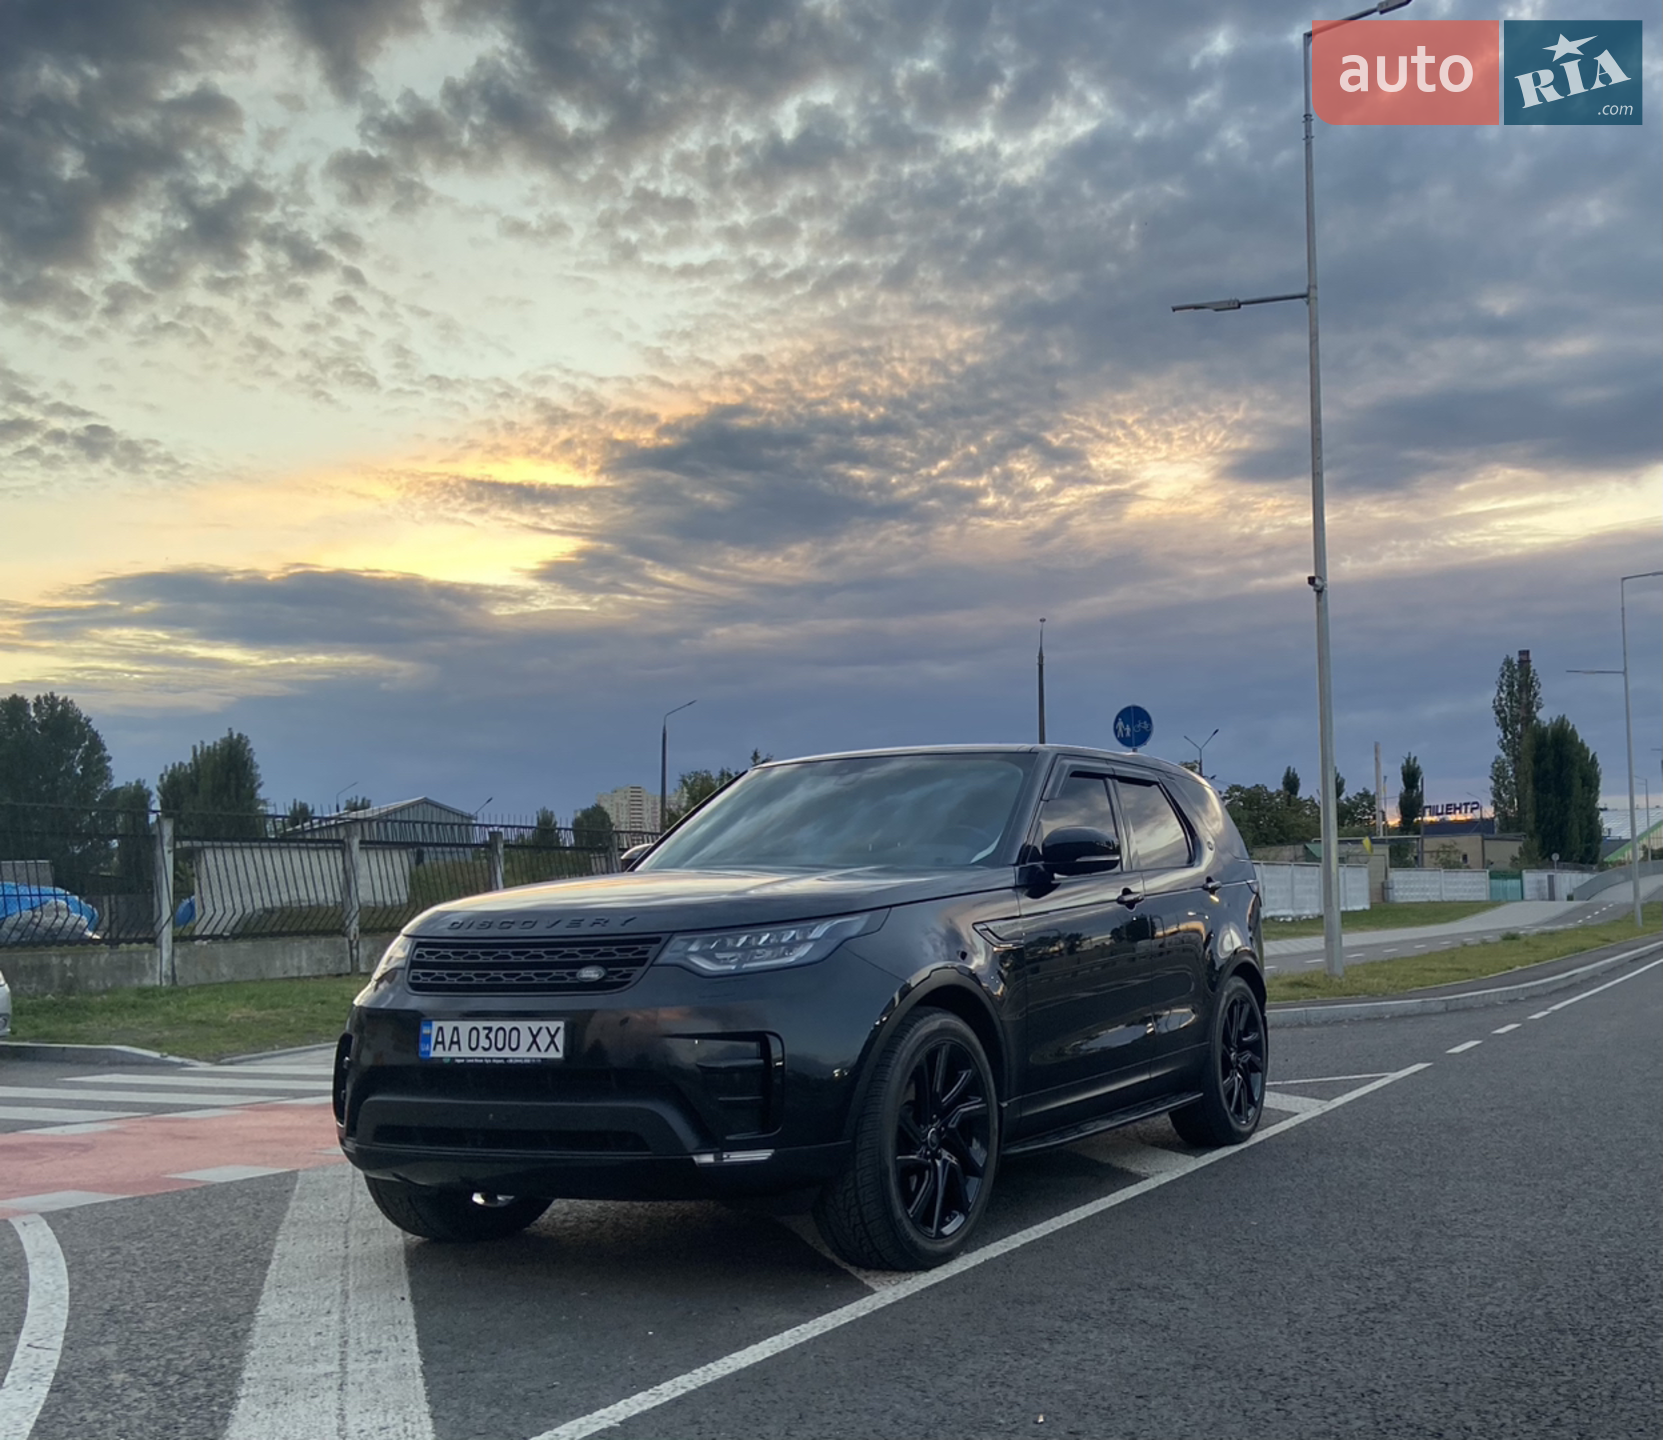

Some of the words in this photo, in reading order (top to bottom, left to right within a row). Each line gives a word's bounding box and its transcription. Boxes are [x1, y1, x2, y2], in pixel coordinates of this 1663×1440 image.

[1423, 801, 1480, 816] ПІЦЕНТР
[448, 916, 636, 931] DISCOVERY
[433, 1026, 461, 1052] AA
[468, 1026, 521, 1052] 0300
[526, 1026, 561, 1052] XX
